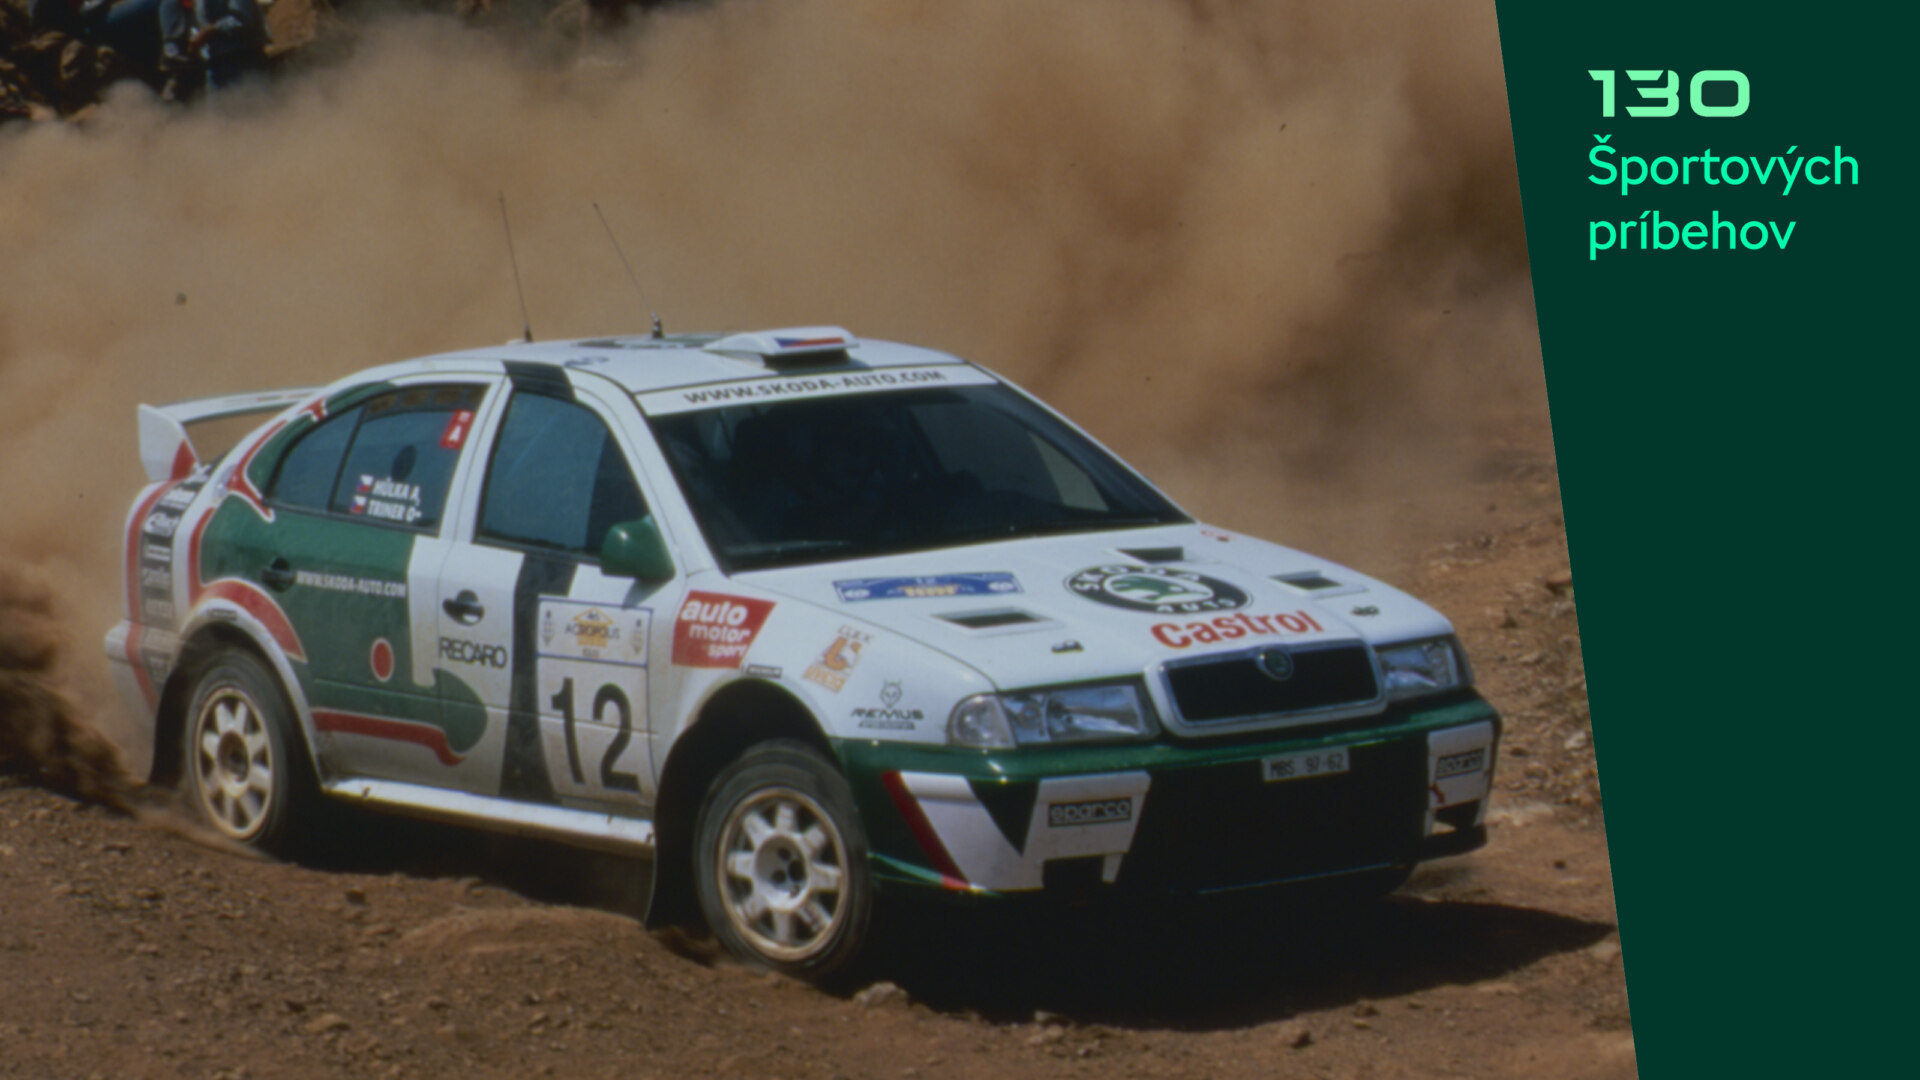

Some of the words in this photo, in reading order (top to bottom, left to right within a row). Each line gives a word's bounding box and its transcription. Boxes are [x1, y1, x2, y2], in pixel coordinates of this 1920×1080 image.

[683, 370, 947, 404] WWW.SKODA-AUTO.COM
[680, 599, 748, 627] auto
[1150, 609, 1324, 649] Castrol
[689, 624, 752, 643] motor
[438, 637, 508, 670] RECARO
[850, 708, 925, 720] REMUS
[552, 676, 641, 793] 12
